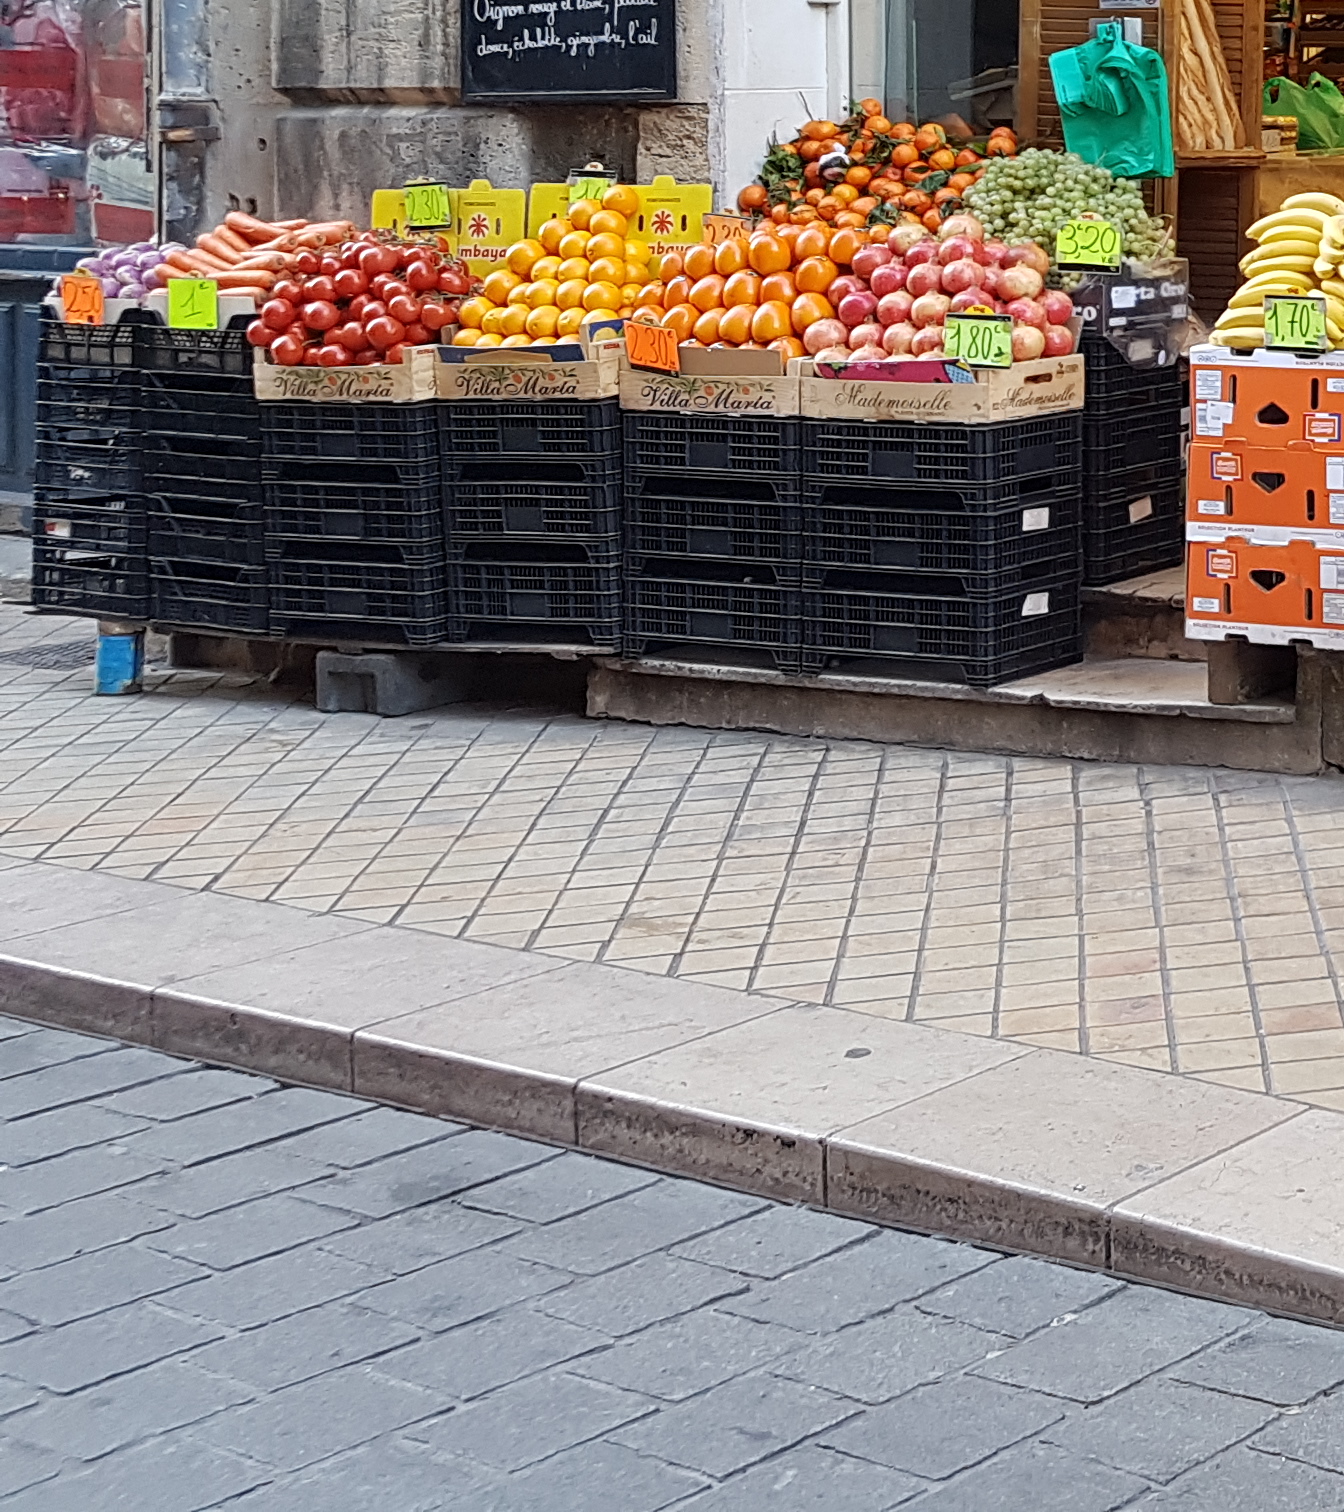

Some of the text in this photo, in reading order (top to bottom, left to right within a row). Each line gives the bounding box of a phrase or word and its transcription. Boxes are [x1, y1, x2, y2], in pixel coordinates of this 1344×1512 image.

[275, 376, 317, 399] Villa
[456, 375, 500, 397] Villa
[641, 385, 690, 409] Villa
[835, 383, 950, 411] Mademoiselle
